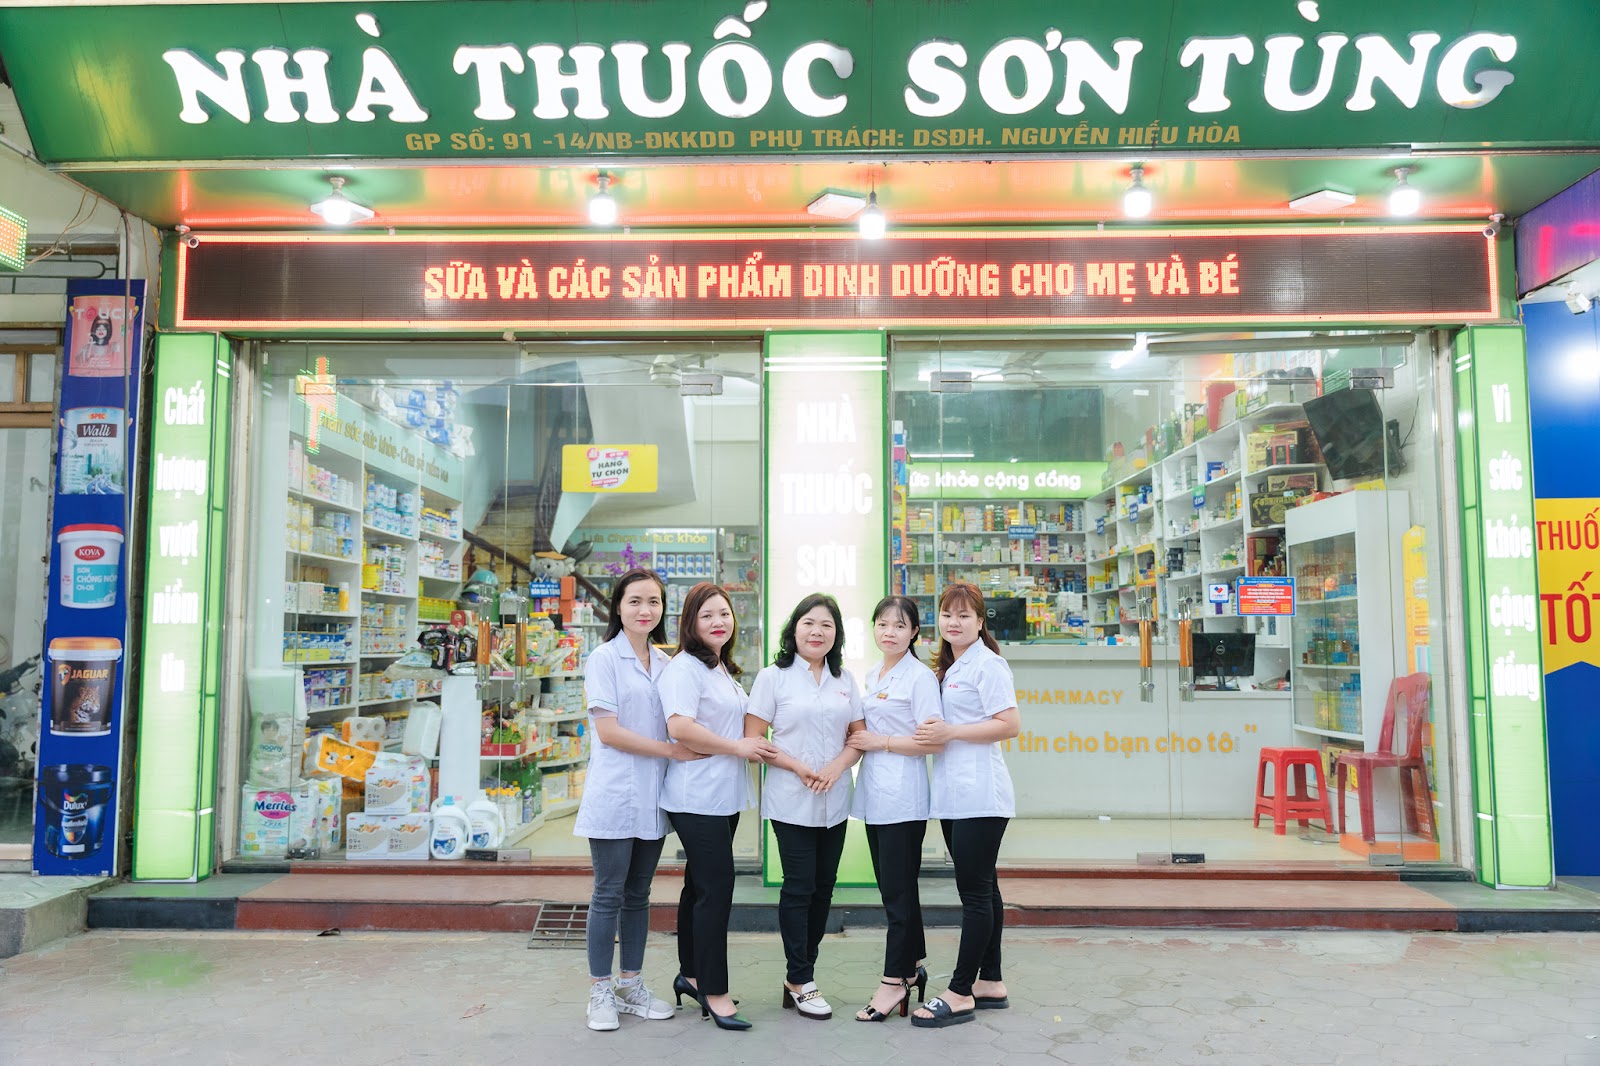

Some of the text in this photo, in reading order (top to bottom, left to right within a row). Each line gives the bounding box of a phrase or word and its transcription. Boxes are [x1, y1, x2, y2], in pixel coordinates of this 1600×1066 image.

[163, 0, 1517, 124] NHÀ THUỐC SƠN TÙNG
[405, 133, 441, 150] GP
[450, 127, 494, 150] SỐ:
[503, 133, 532, 149] 91
[750, 130, 803, 150] PHỤ
[812, 126, 904, 147] TRÁCH:
[913, 128, 992, 147] DSĐH.
[1001, 120, 1109, 145] NGUYỄN
[1118, 120, 1178, 145] HIẾU
[1186, 121, 1240, 143] HÒA
[424, 251, 1240, 303] SỮA VÀ CÁC SẢN PHẨM DINH DƯỠNG CHO MẸ VÀ BÉ
[164, 380, 206, 425] Chất
[796, 393, 857, 443] NHÀ
[1491, 384, 1512, 423] Vì
[82, 424, 111, 437] Walli
[156, 452, 207, 499] lượng
[779, 459, 873, 515] THUỐC
[909, 470, 1082, 491] ức khỏe cộng đồng
[1488, 449, 1522, 491] sức
[1485, 514, 1532, 559] khỏe
[1536, 507, 1600, 551] THUỐ
[79, 548, 101, 556] KOVA
[796, 543, 857, 587] SƠN
[1490, 586, 1536, 635] cộng
[1540, 571, 1600, 645] TỐ
[71, 669, 108, 679] JAGUAR
[1493, 650, 1539, 701] đồng
[1015, 689, 1123, 705] PHARMACY
[1017, 731, 1048, 753] tin
[1053, 731, 1099, 753] cho
[1104, 731, 1150, 758] bạn
[1155, 731, 1202, 753] cho
[63, 801, 85, 810] Dulux
[253, 800, 297, 812] Merries
